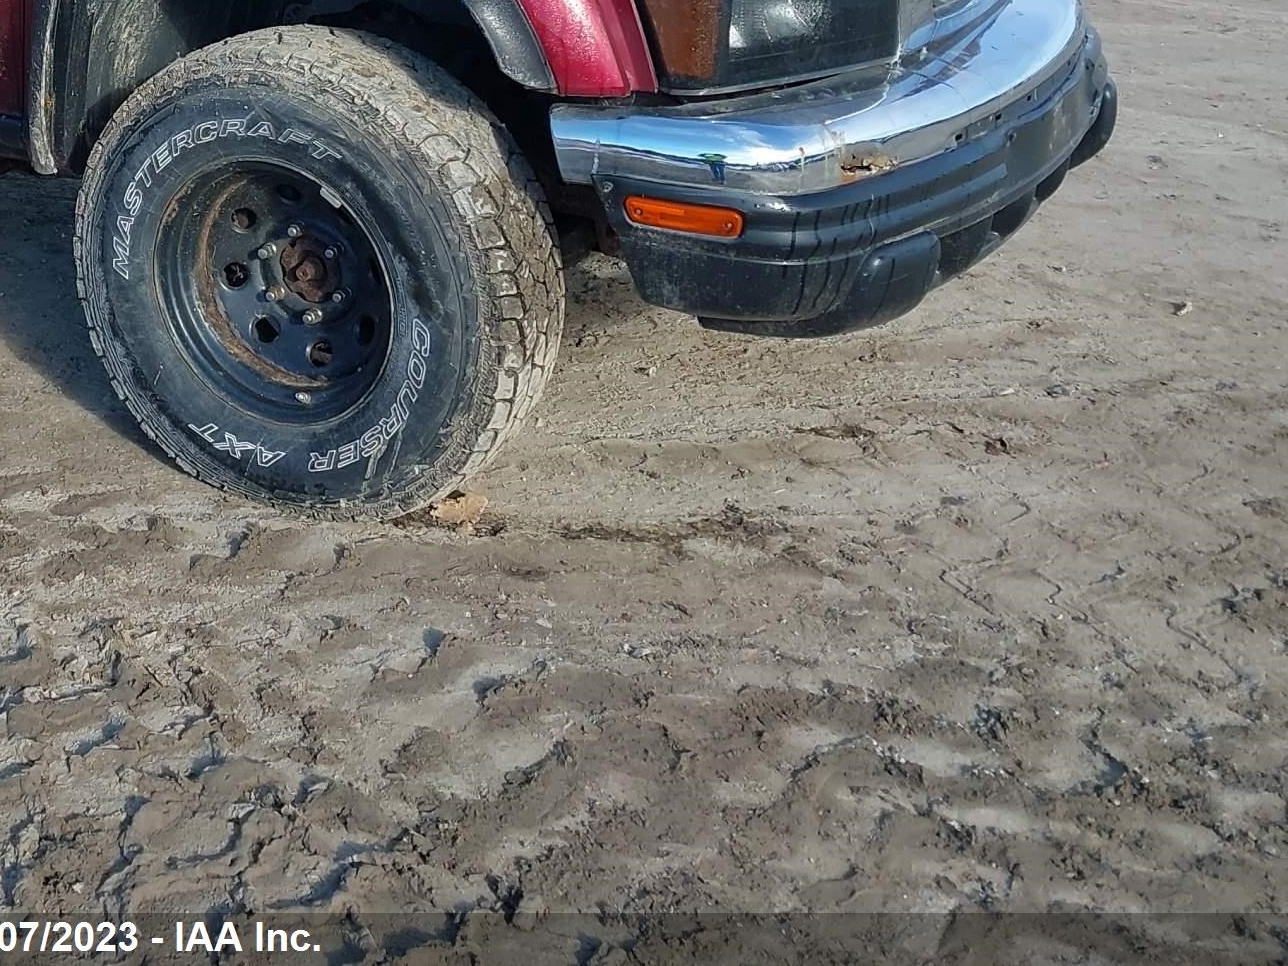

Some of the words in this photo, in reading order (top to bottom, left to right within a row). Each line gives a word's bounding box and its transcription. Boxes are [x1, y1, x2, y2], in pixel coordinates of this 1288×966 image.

[112, 118, 343, 280] MASTERCRAFT
[189, 421, 287, 468] AXT
[308, 319, 431, 472] COURSER
